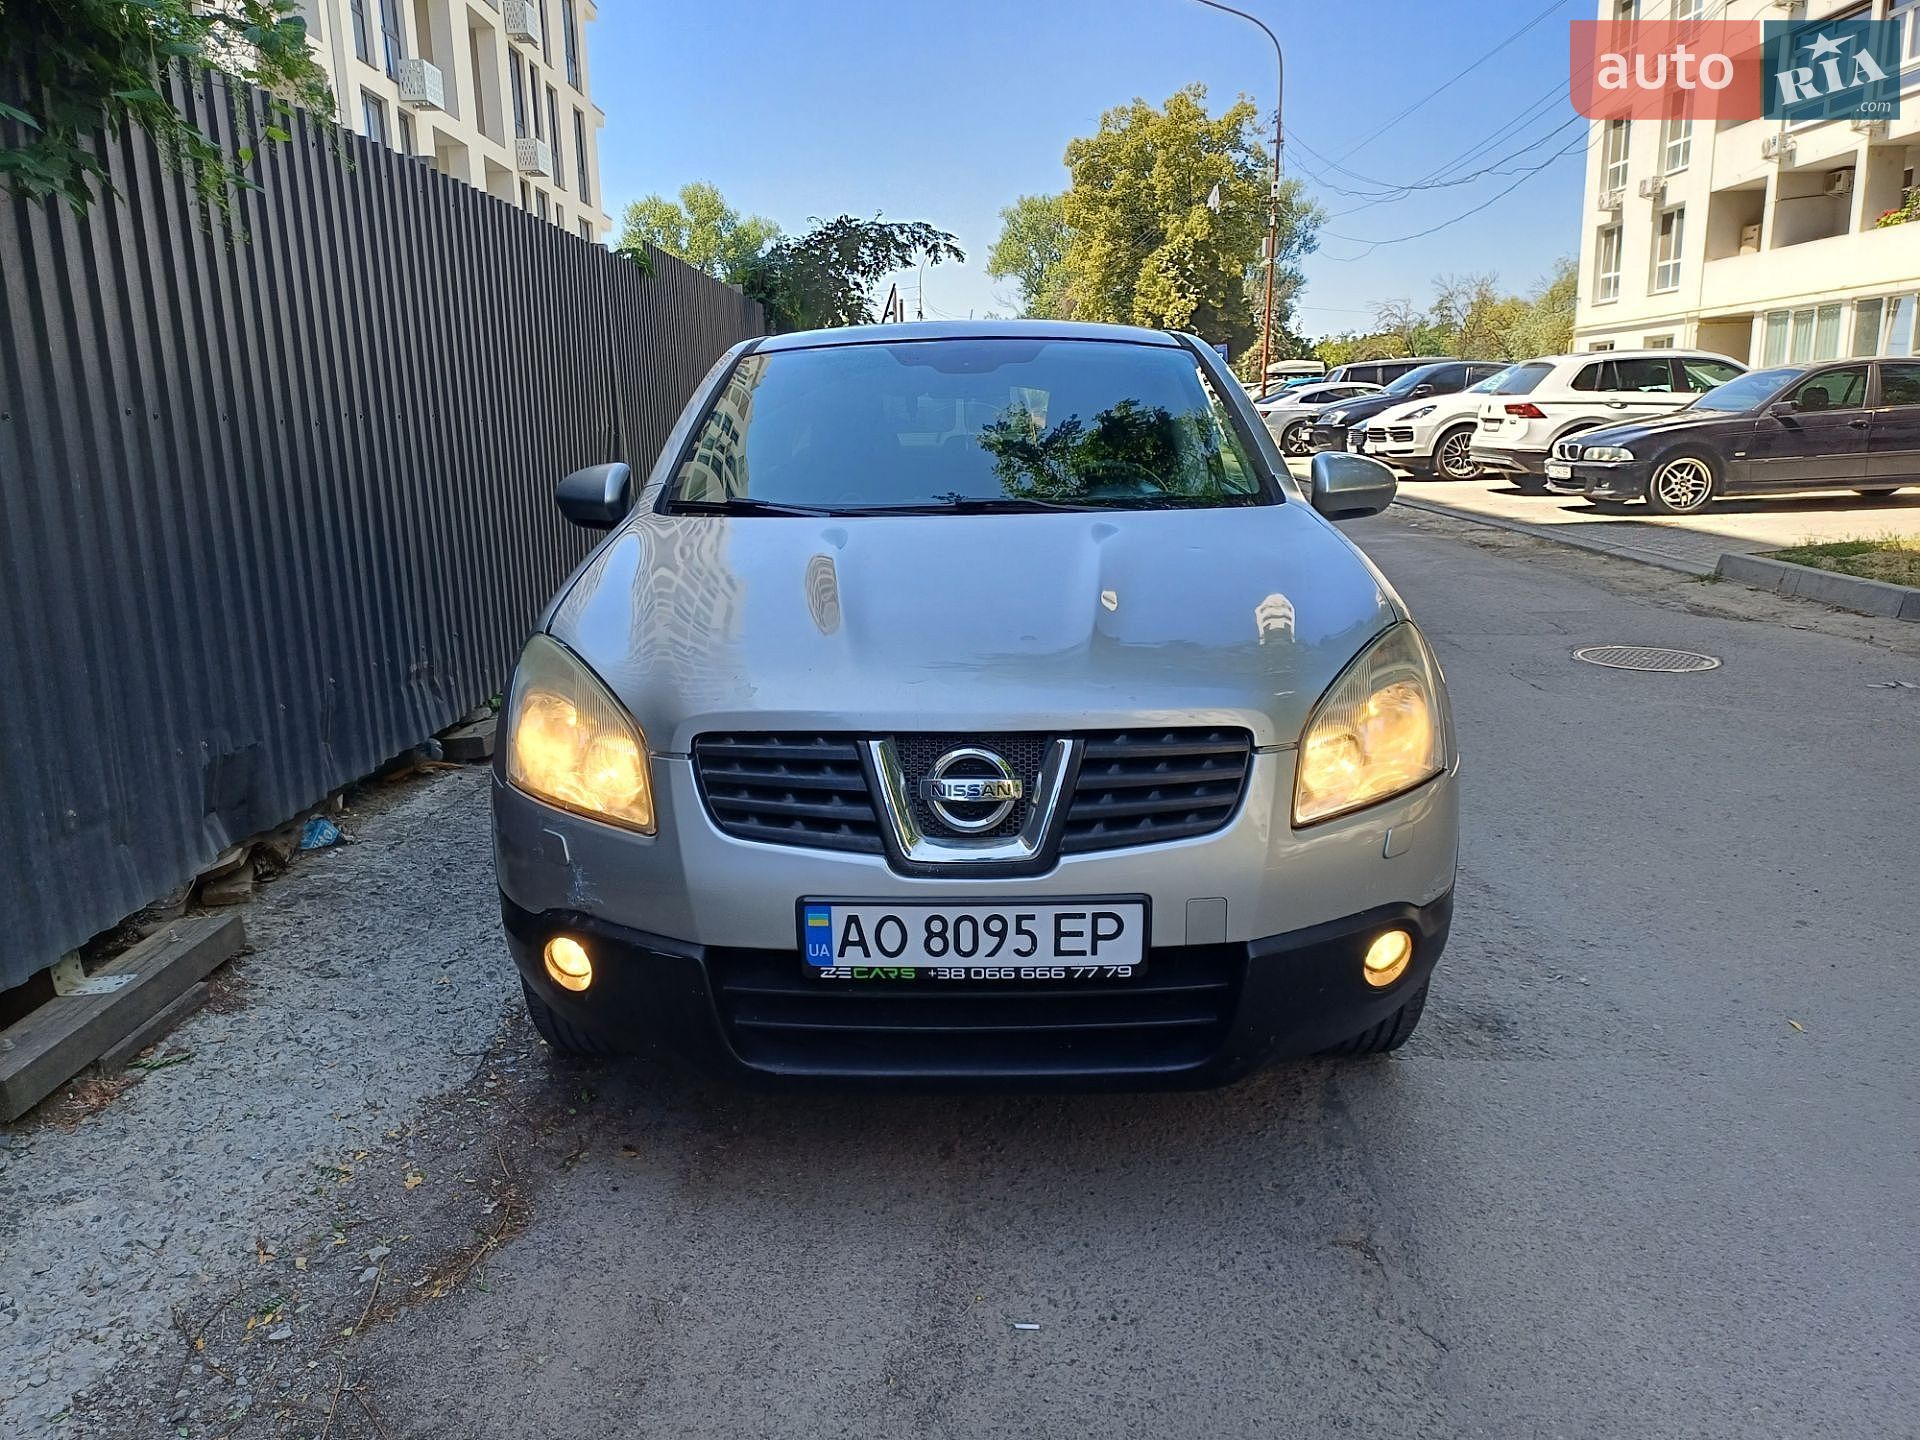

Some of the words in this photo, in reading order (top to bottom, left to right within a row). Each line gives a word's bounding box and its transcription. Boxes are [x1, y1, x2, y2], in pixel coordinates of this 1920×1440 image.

[930, 784, 1012, 798] NISSAN
[837, 914, 908, 958] AO
[923, 913, 1038, 958] 8095
[1053, 911, 1125, 957] EP
[808, 943, 830, 957] UA
[928, 967, 966, 979] +38
[970, 967, 1015, 979] 066
[1020, 966, 1066, 979] 666
[1070, 966, 1098, 978] 77
[1103, 965, 1132, 978] 79
